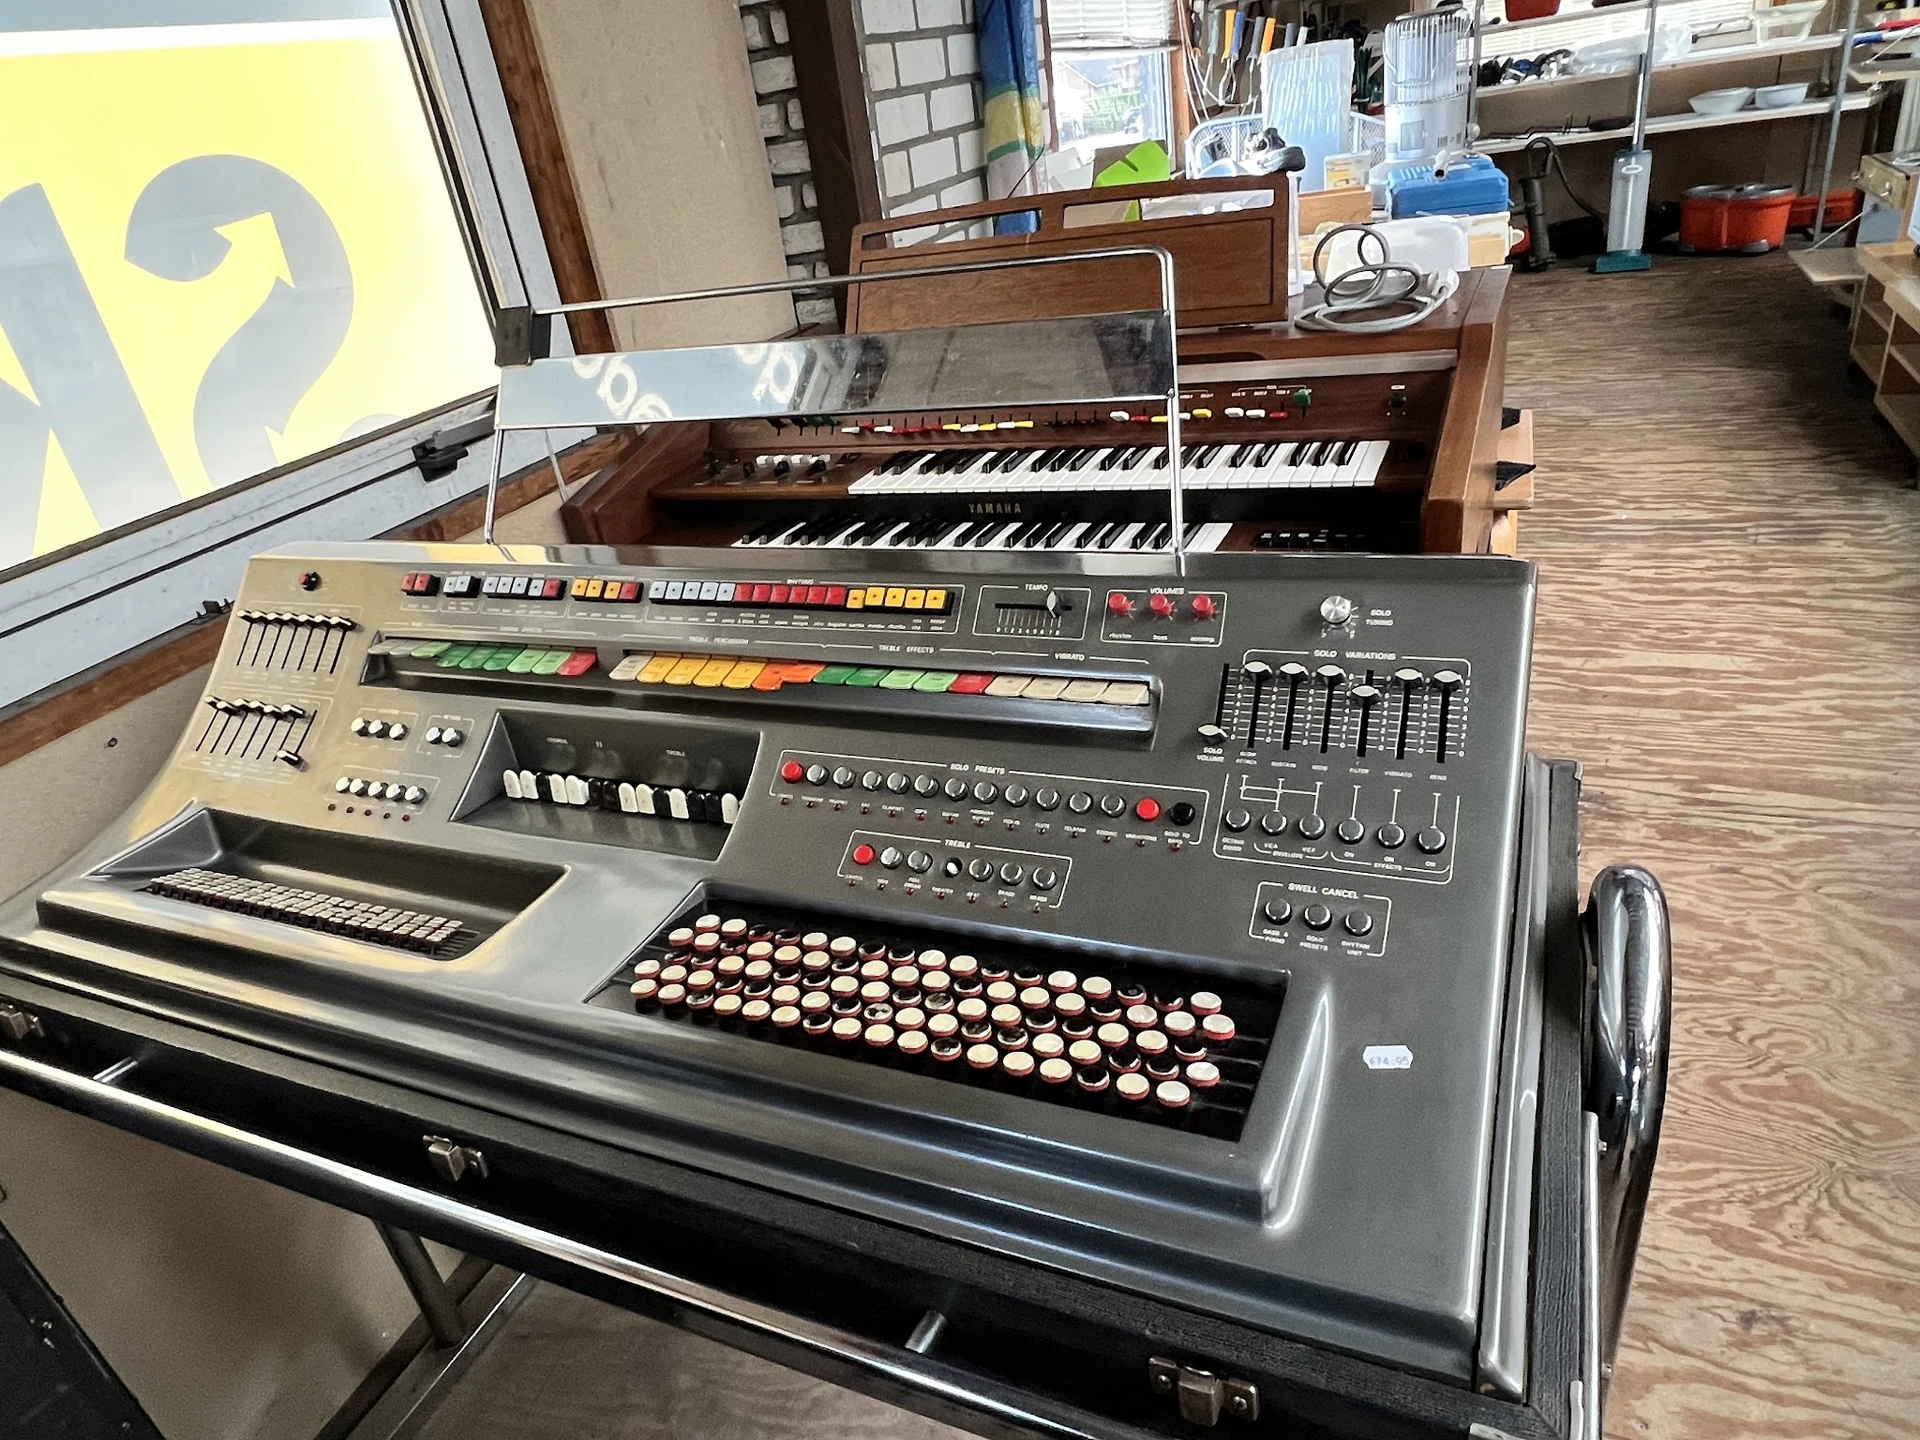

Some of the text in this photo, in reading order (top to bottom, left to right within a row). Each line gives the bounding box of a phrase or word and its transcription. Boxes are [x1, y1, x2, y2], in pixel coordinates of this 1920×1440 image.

[968, 502, 1021, 514] YAMAHA
[1025, 583, 1049, 592] TEMPO
[1150, 587, 1185, 596] VOLUMES
[1054, 652, 1086, 661] VIBRATO
[1314, 649, 1396, 661] SOLO VARIATIONS
[1203, 746, 1223, 755] SOLO
[950, 763, 969, 772] SOLO
[945, 838, 971, 849] TREBLE
[1373, 862, 1403, 872] EFFECTS
[1287, 882, 1360, 899] SWELL CANCEL
[1341, 940, 1371, 950] RHYTHM
[1347, 949, 1363, 957] UNIT
[1369, 1055, 1410, 1067] €74.95
